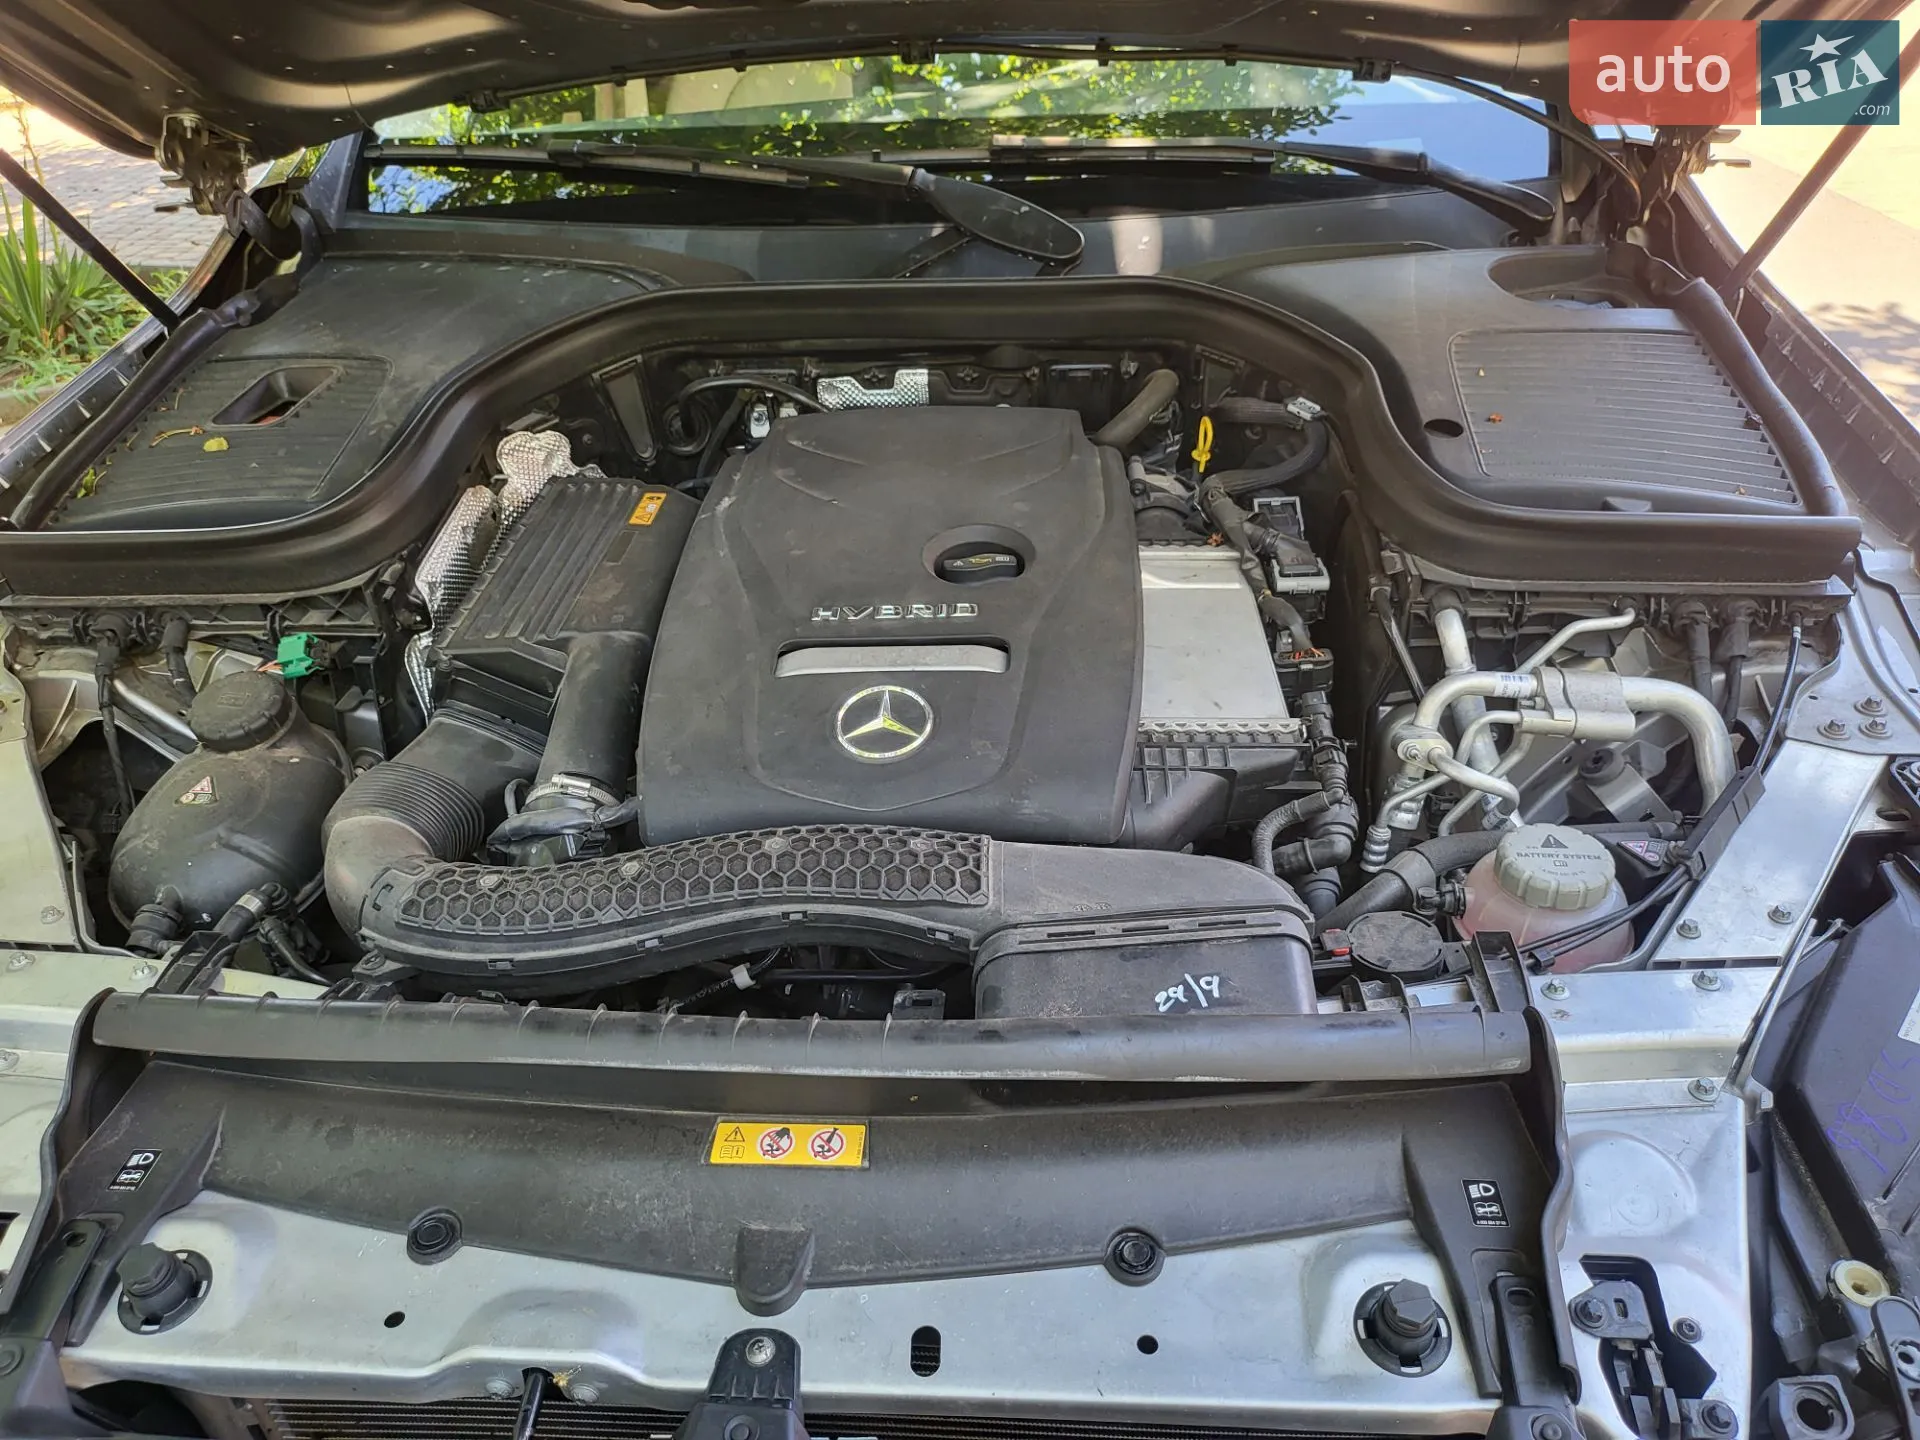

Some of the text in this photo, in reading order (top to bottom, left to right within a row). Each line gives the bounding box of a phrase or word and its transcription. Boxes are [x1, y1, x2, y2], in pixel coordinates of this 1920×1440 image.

[811, 603, 978, 621] HYBRID
[1516, 851, 1602, 861] BATTERY SYSTEM
